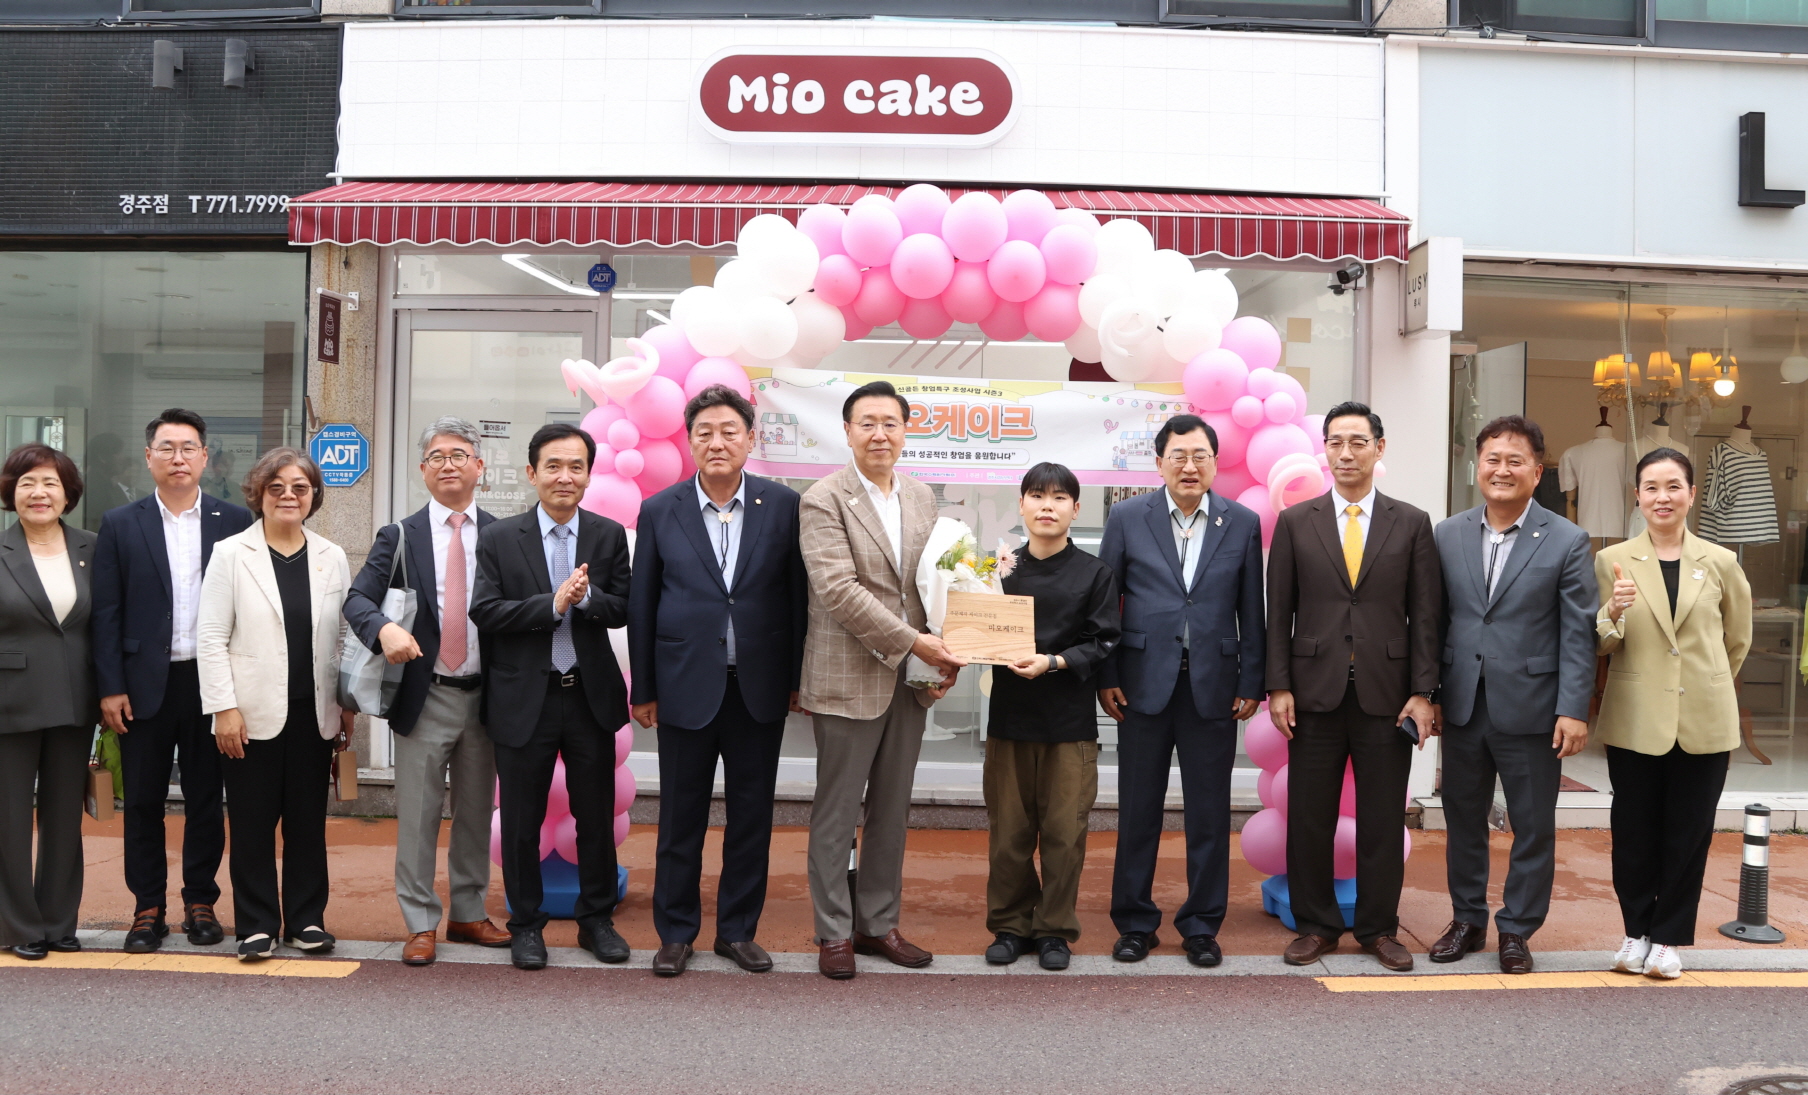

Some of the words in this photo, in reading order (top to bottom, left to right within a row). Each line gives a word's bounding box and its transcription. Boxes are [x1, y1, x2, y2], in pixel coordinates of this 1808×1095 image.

[727, 72, 826, 115] Mio
[843, 73, 984, 117] cake
[118, 193, 170, 216] 경주점
[188, 195, 202, 214] T
[206, 194, 290, 214] 771.7999
[591, 272, 611, 283] ADT
[1407, 271, 1428, 296] LUSY
[952, 386, 981, 395] 조성사업
[905, 403, 1036, 441] 오케이크
[320, 444, 359, 465] ADT
[900, 450, 916, 458] 들의
[918, 450, 948, 459] 성공적인
[950, 451, 972, 460] 창업을
[474, 490, 526, 500] EN&CLOSE
[988, 624, 1025, 633] 미오케이크
